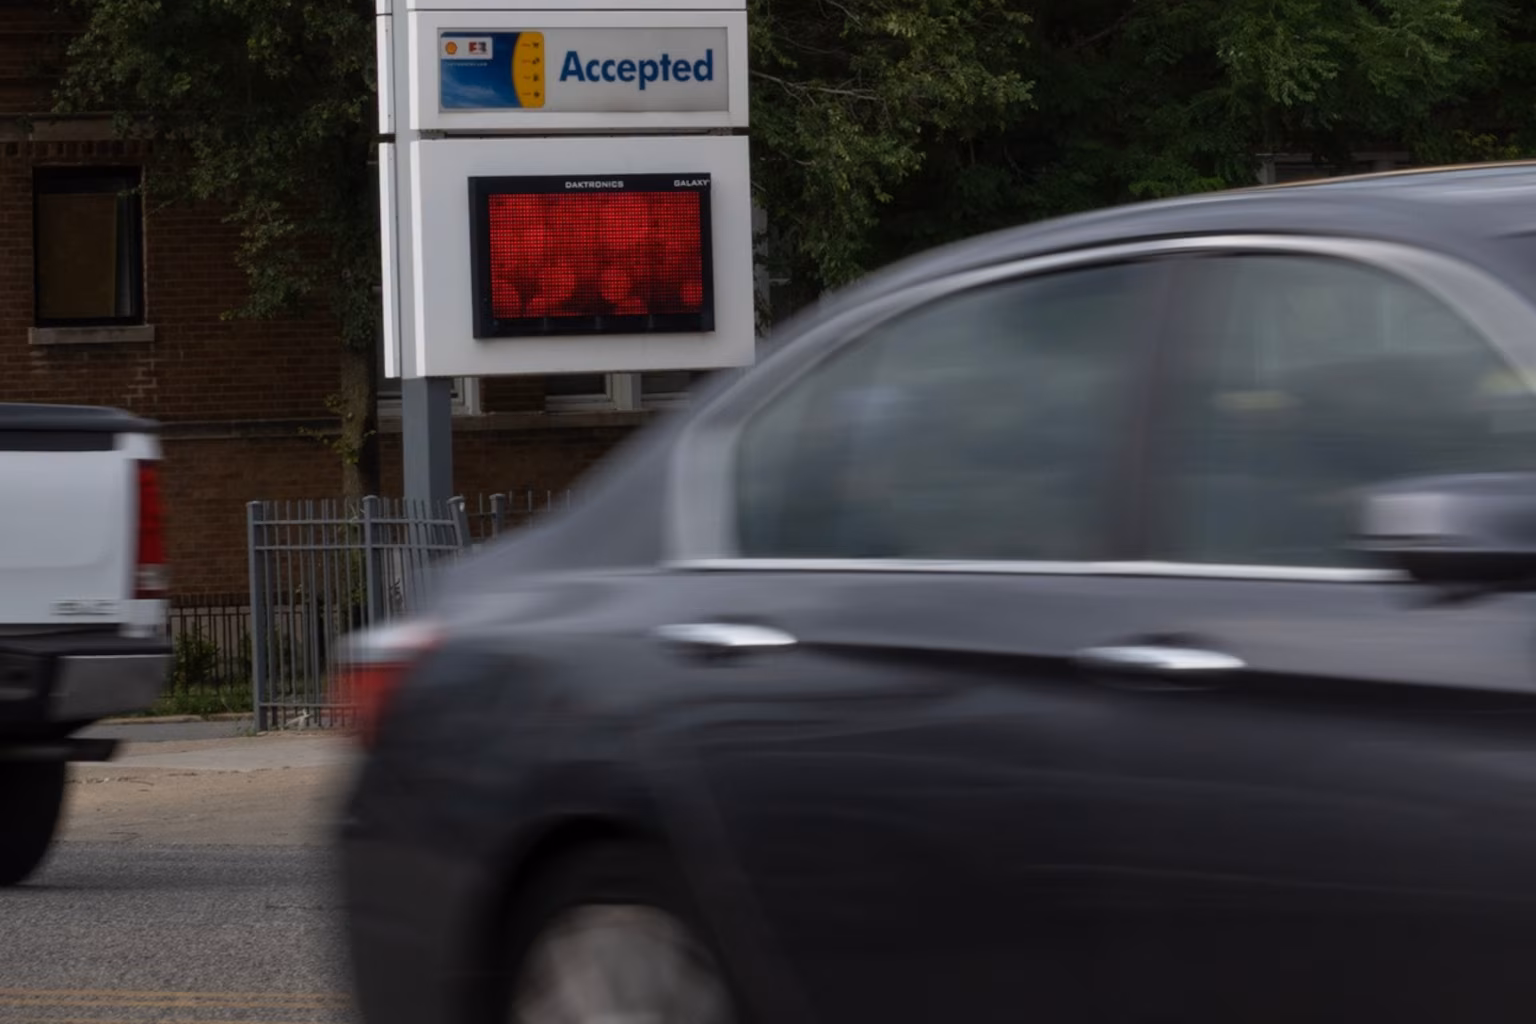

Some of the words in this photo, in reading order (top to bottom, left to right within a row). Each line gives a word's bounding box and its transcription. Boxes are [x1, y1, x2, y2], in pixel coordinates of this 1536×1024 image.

[559, 48, 713, 91] Accepted
[565, 181, 624, 189] DAKTRONICS
[673, 179, 708, 187] GALAXY
